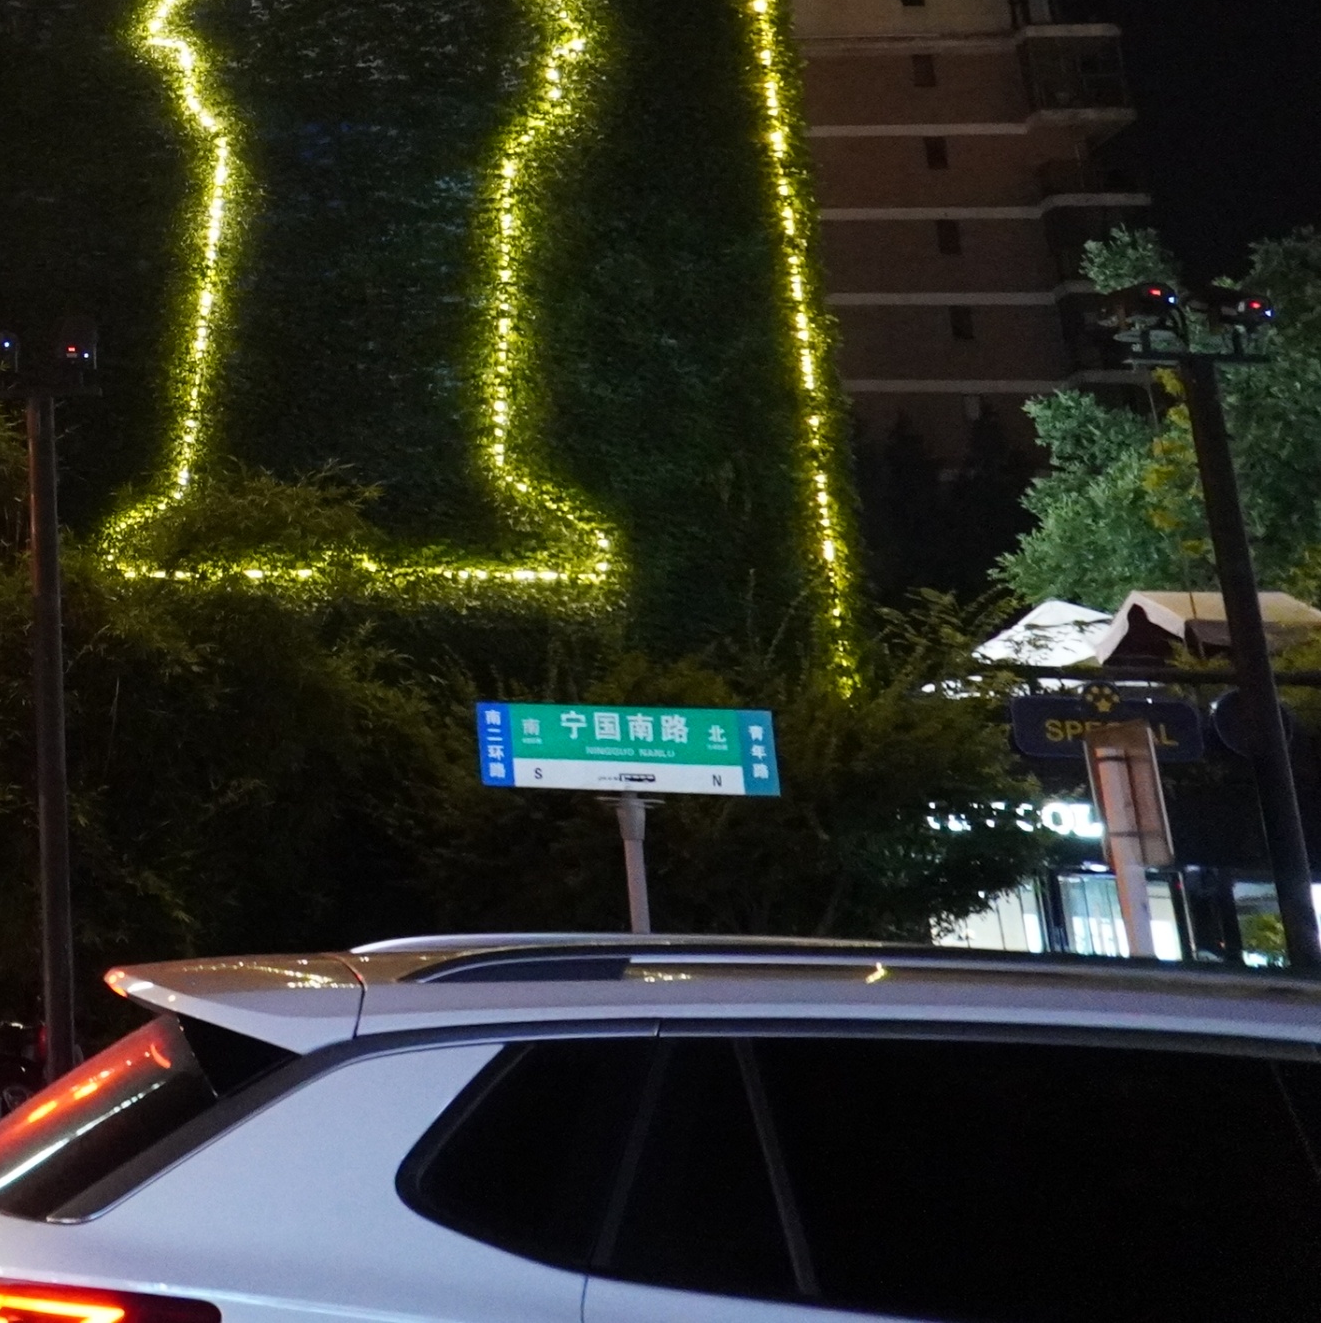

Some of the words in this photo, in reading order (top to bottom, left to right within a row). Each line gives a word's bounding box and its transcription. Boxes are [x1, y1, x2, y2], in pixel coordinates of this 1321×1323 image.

[521, 718, 541, 736] 南
[560, 710, 689, 744] 宁国南路
[708, 725, 727, 742] 北
[485, 710, 506, 778] 南二环路
[534, 767, 543, 780] S
[712, 774, 722, 787] N
